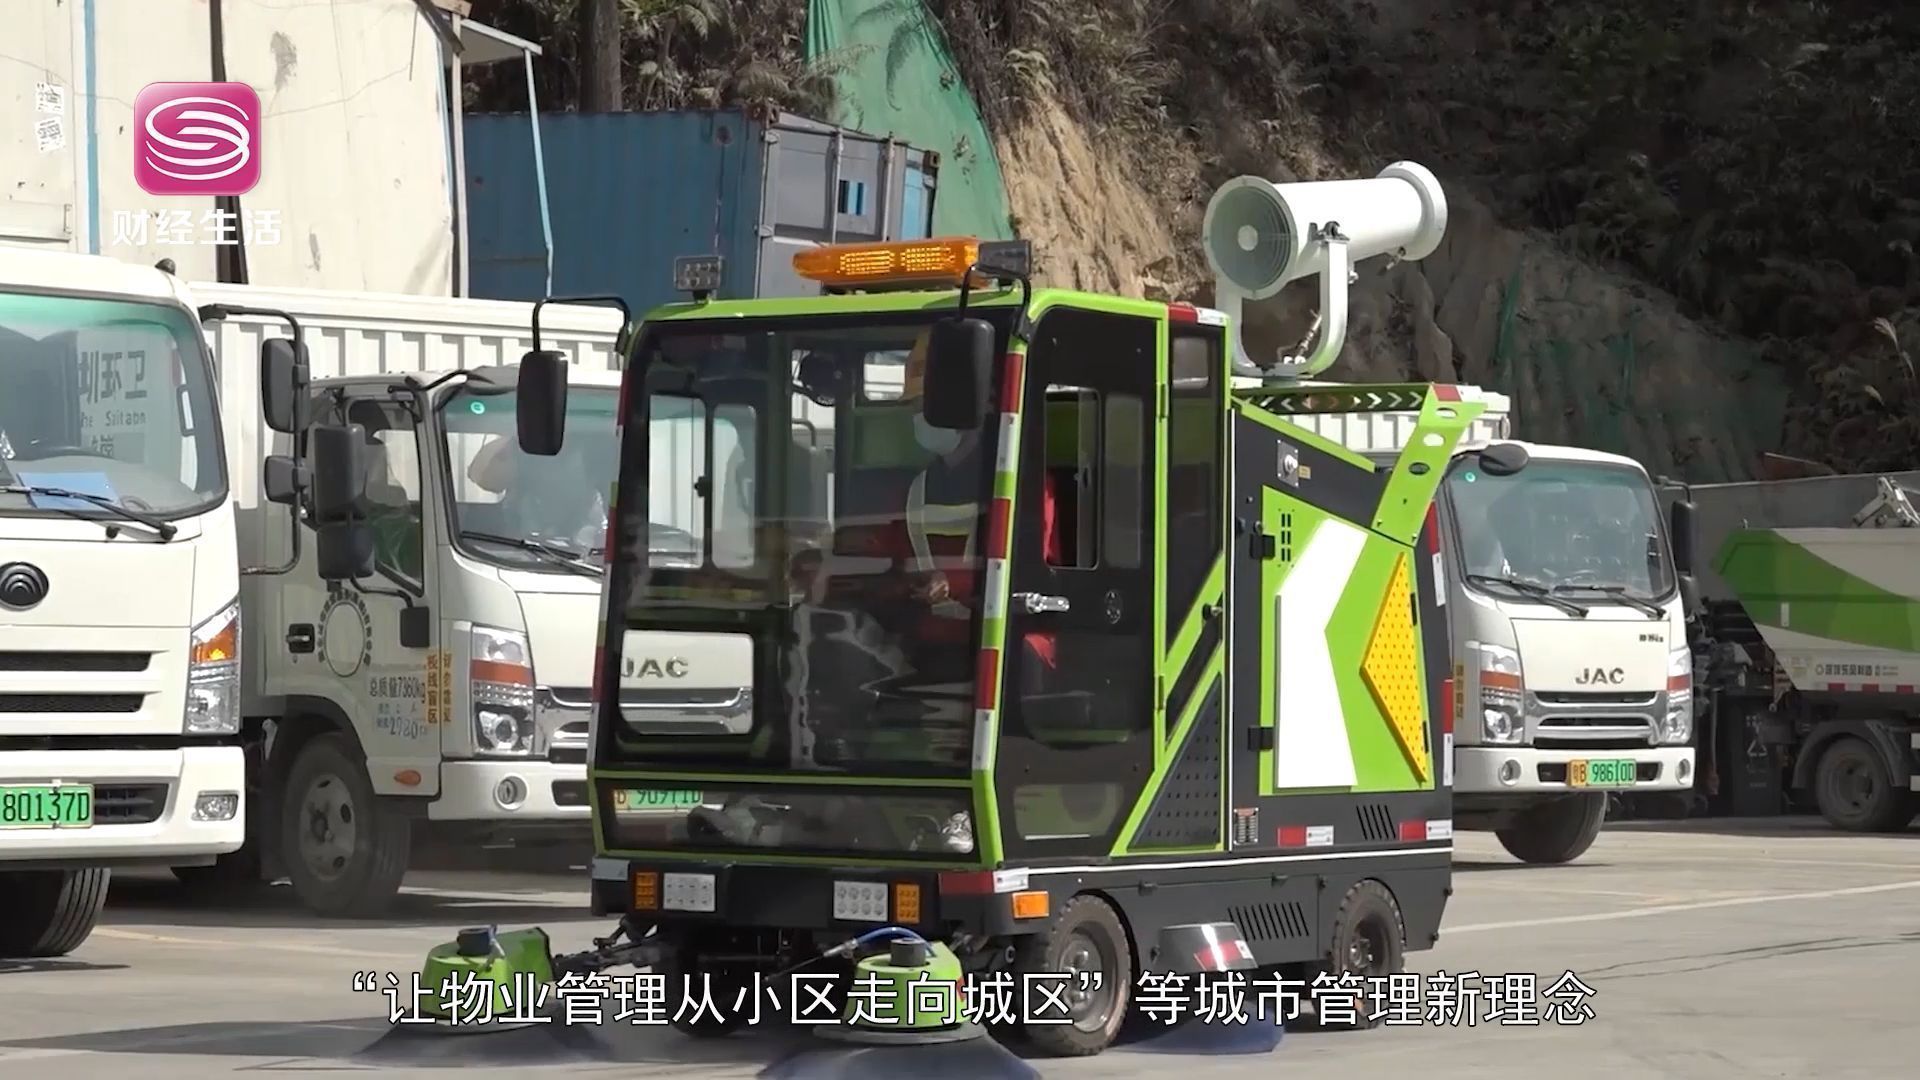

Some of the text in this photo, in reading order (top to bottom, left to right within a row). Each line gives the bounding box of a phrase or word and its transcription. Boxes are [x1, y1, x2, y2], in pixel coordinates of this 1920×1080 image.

[620, 657, 689, 679] JAC
[1575, 667, 1625, 685] JAC
[3, 792, 90, 822] 80137D
